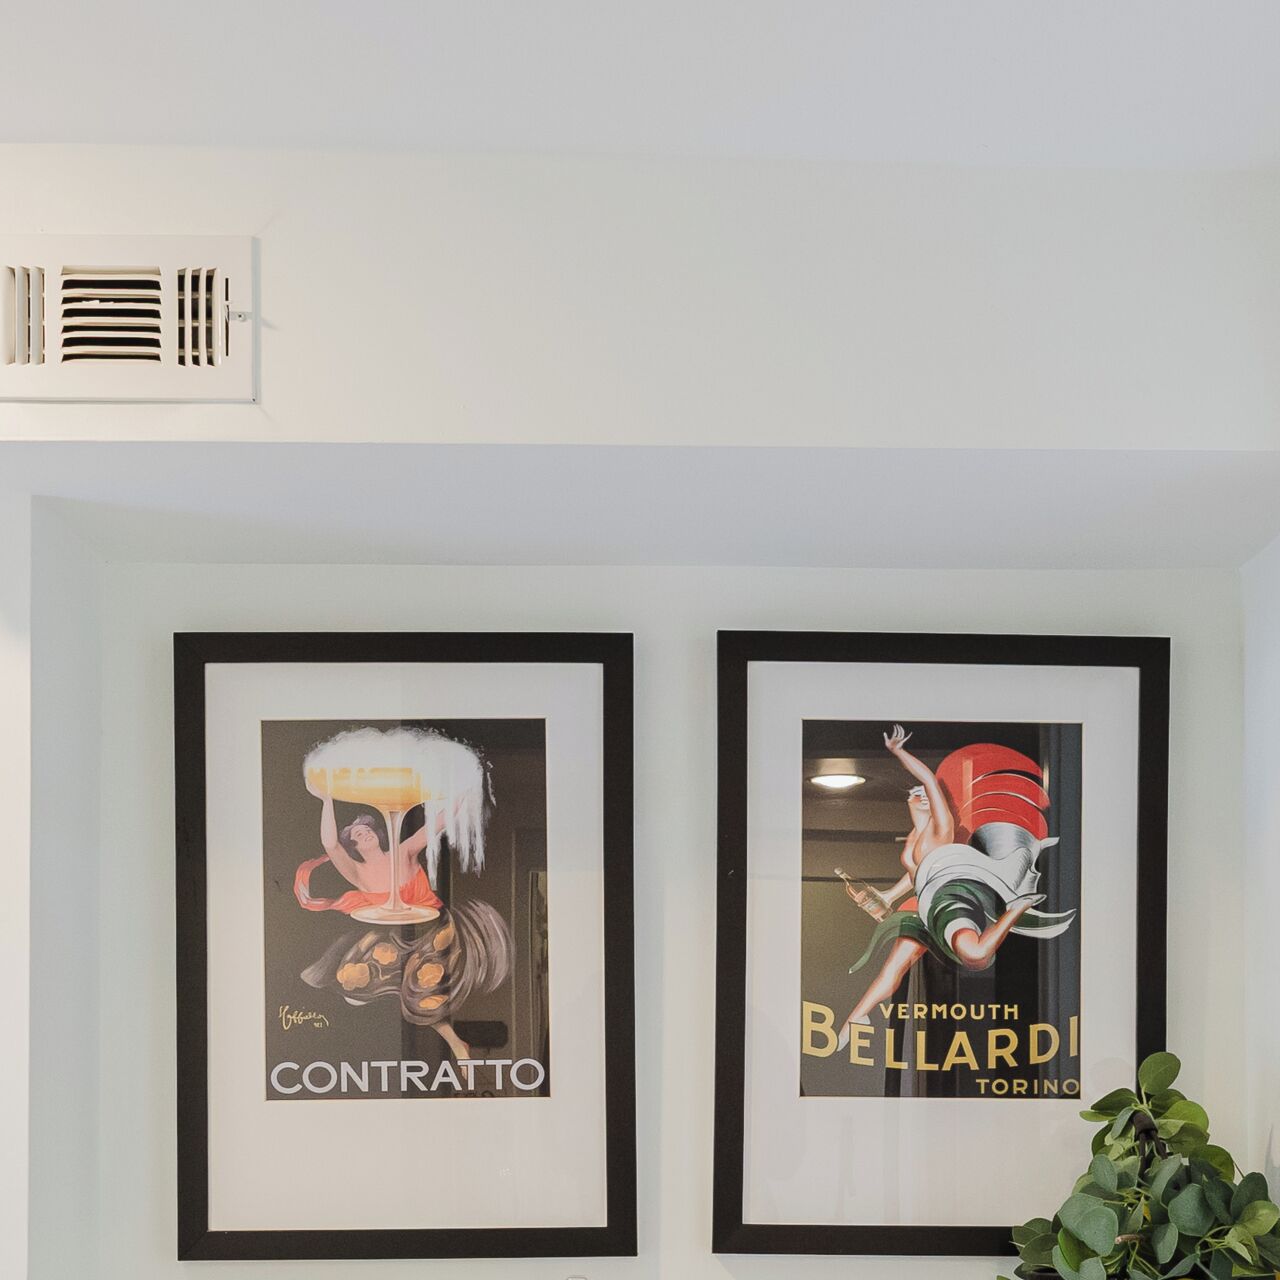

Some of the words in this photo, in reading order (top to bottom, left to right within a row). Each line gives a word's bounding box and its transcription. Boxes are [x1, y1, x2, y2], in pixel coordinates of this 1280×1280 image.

[879, 1003, 1019, 1020] VERMOUTH
[802, 1001, 1078, 1071] BELLARDI
[270, 1058, 545, 1094] CONTRATTO
[976, 1079, 1080, 1095] TORINO
